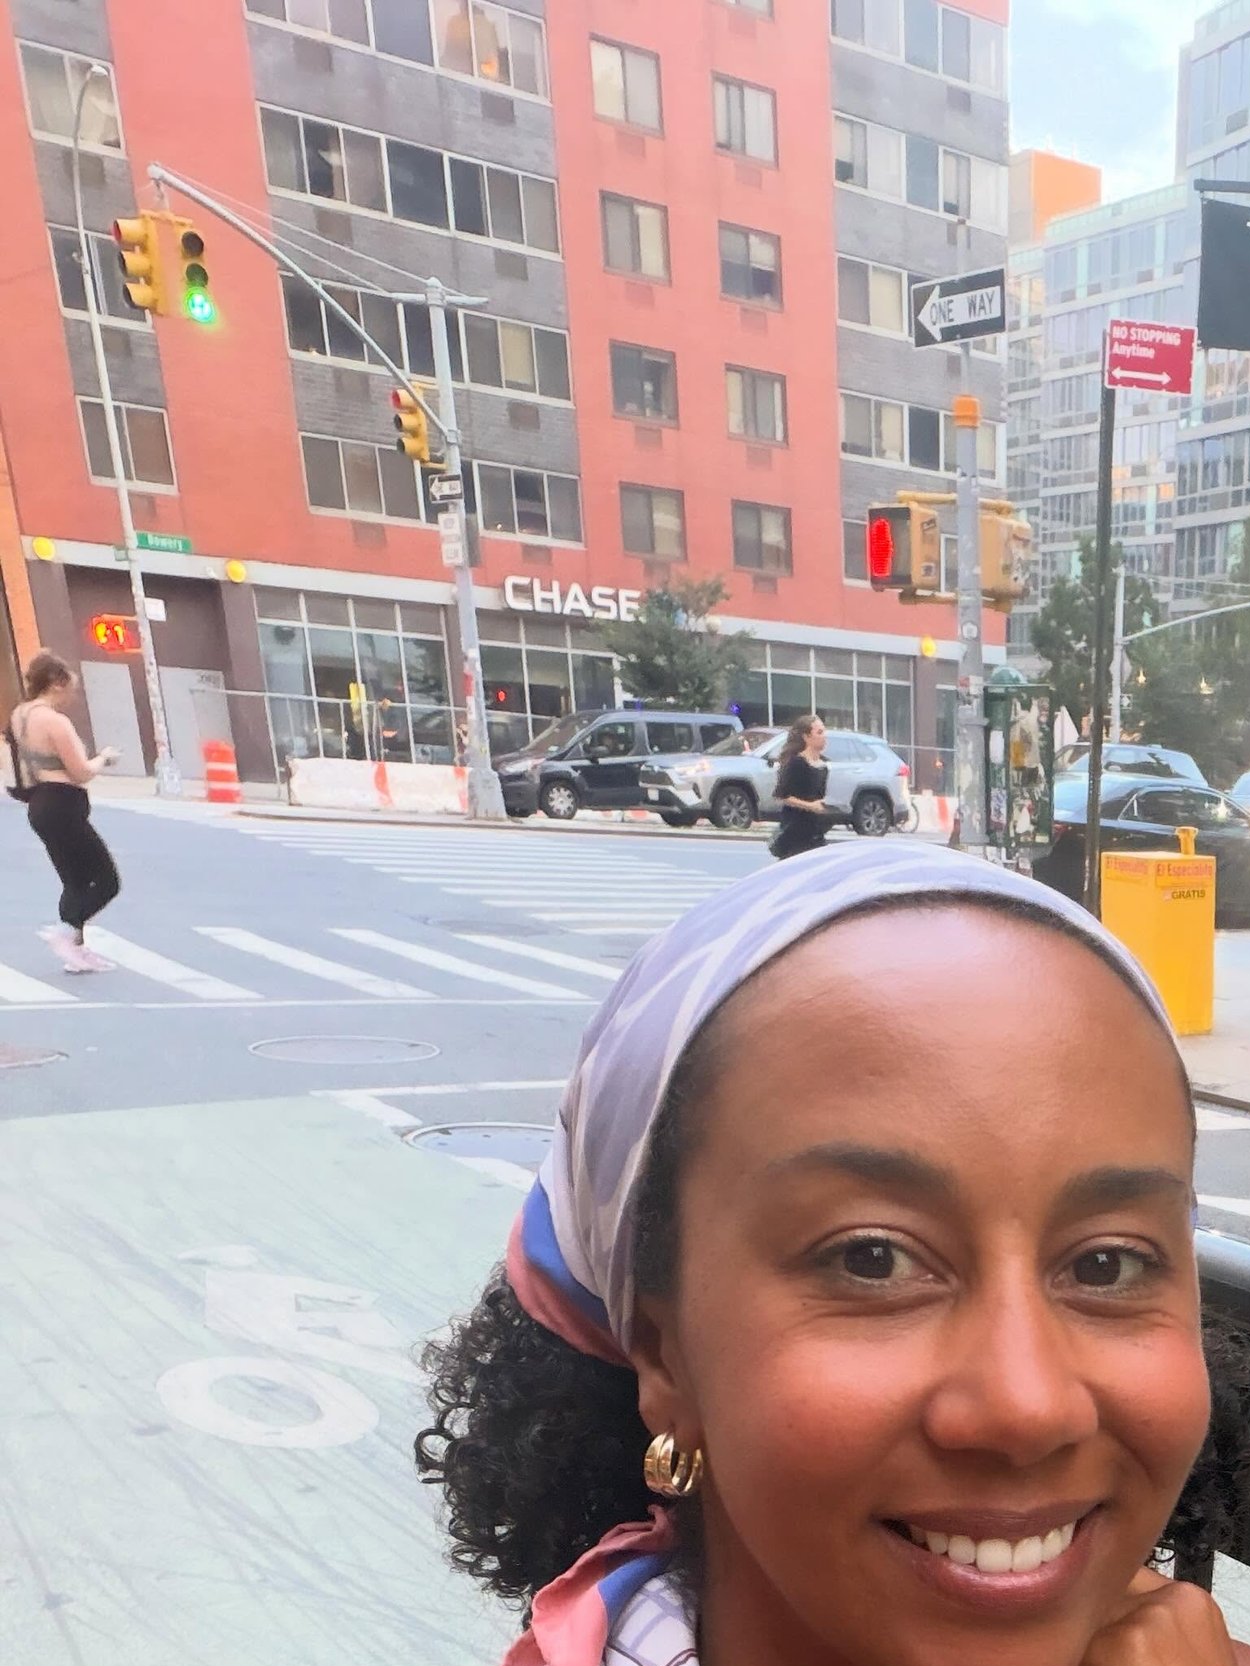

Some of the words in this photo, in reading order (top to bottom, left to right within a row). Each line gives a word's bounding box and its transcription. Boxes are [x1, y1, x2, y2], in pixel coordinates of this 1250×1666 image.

[930, 299, 954, 326] ONE
[967, 290, 995, 320] WAY
[1112, 326, 1128, 340] NO
[1130, 327, 1182, 346] STOPPING
[1112, 341, 1156, 359] Anytime
[504, 575, 643, 622] CHASE
